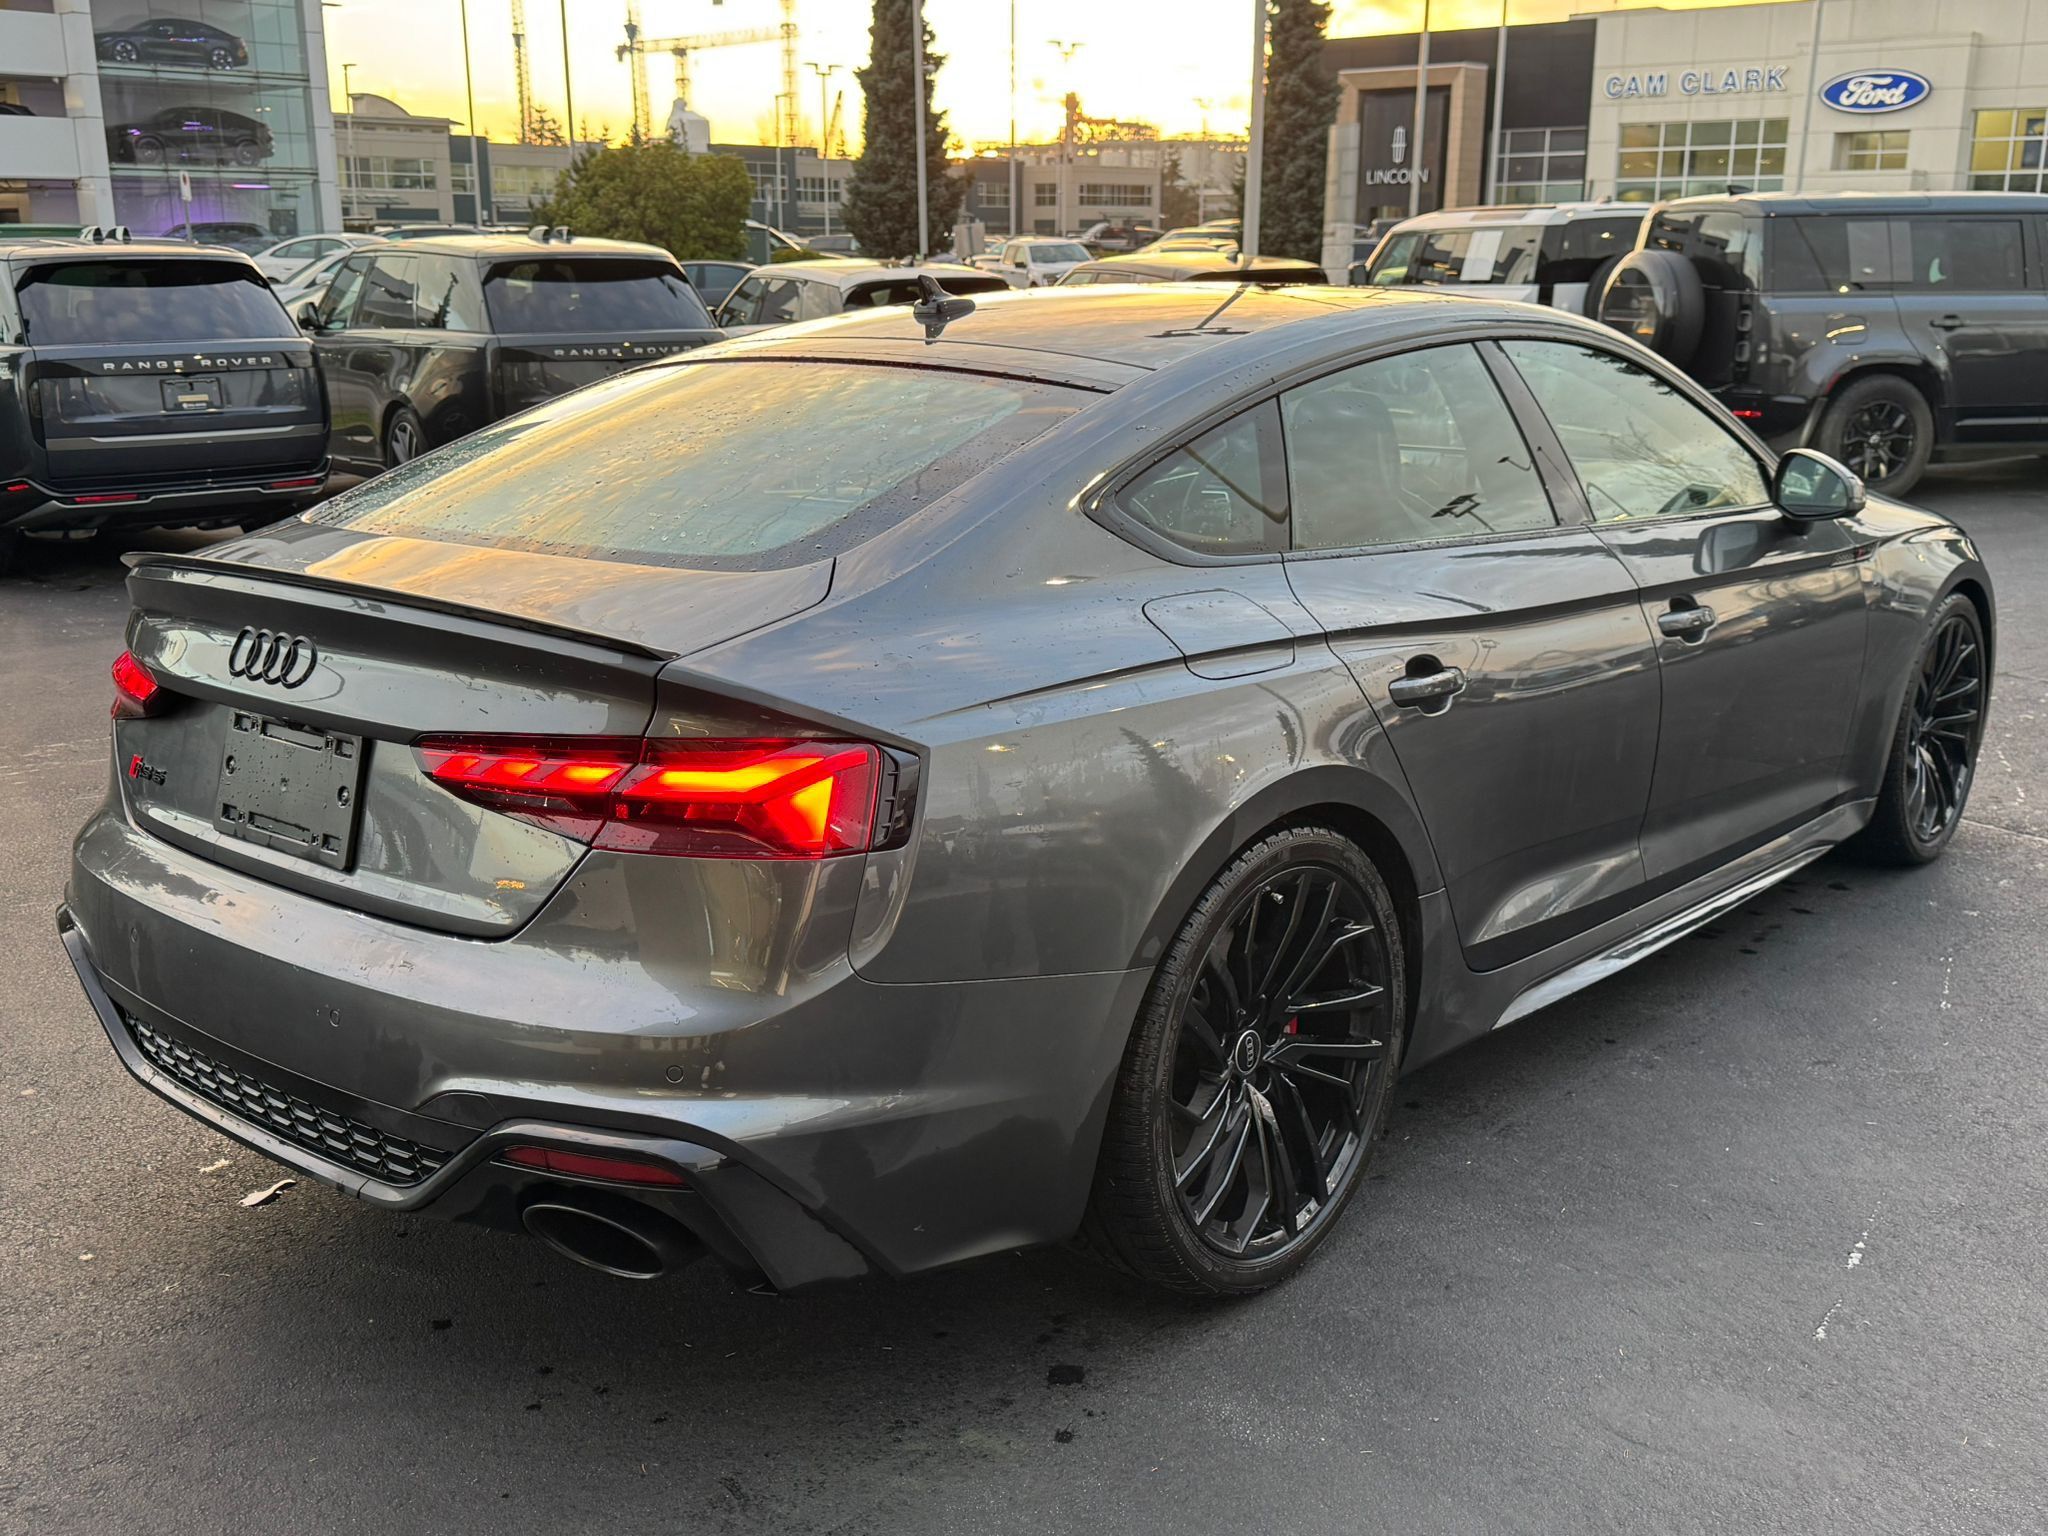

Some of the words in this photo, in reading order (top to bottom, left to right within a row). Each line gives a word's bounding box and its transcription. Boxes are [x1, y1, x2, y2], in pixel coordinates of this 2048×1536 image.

[1603, 72, 1668, 98] CAM
[1679, 64, 1790, 95] CLARK
[1839, 76, 1909, 106] Ford
[554, 347, 622, 357] RANGE
[103, 360, 184, 371] RANGE
[201, 356, 273, 368] ROVER
